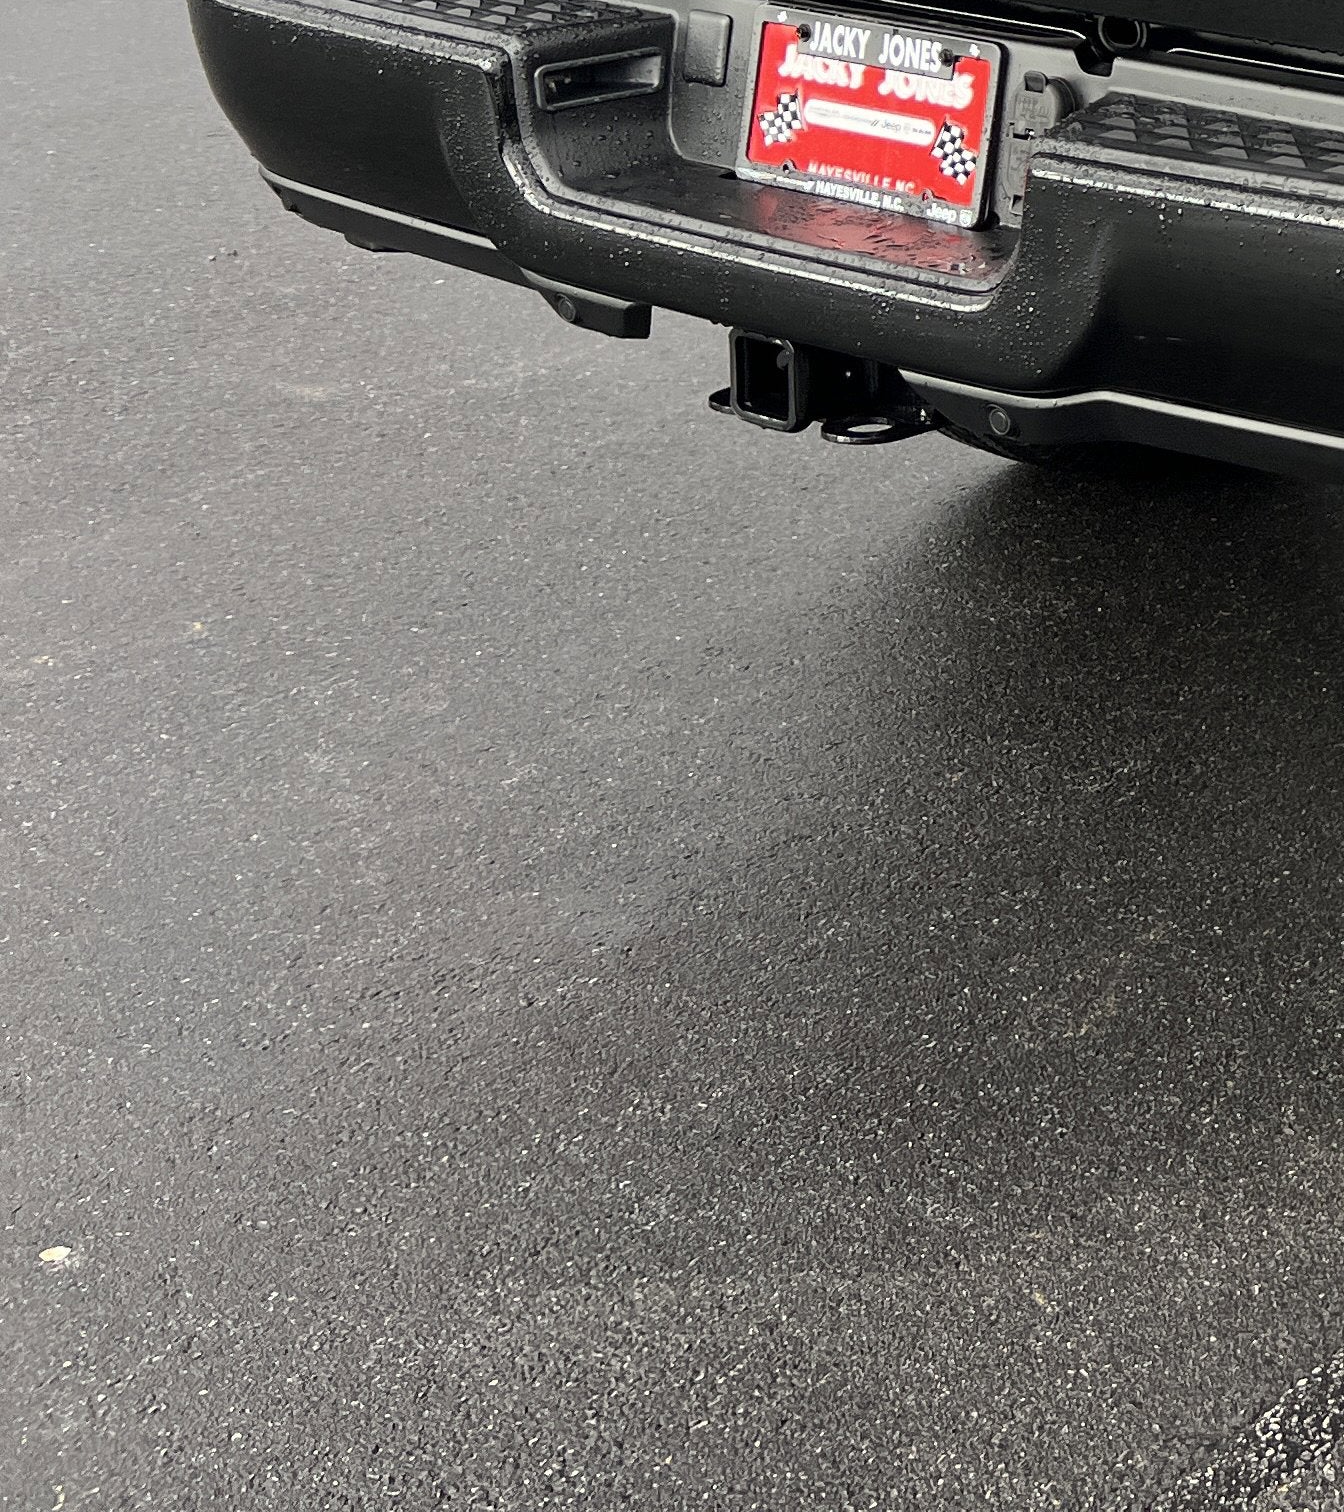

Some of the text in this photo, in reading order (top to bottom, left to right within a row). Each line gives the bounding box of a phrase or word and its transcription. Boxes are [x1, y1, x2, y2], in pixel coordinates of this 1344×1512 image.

[809, 21, 942, 73] JACKY JONES
[778, 43, 866, 89] JACKY
[877, 68, 975, 110] JONES
[926, 202, 957, 223] Jeep
